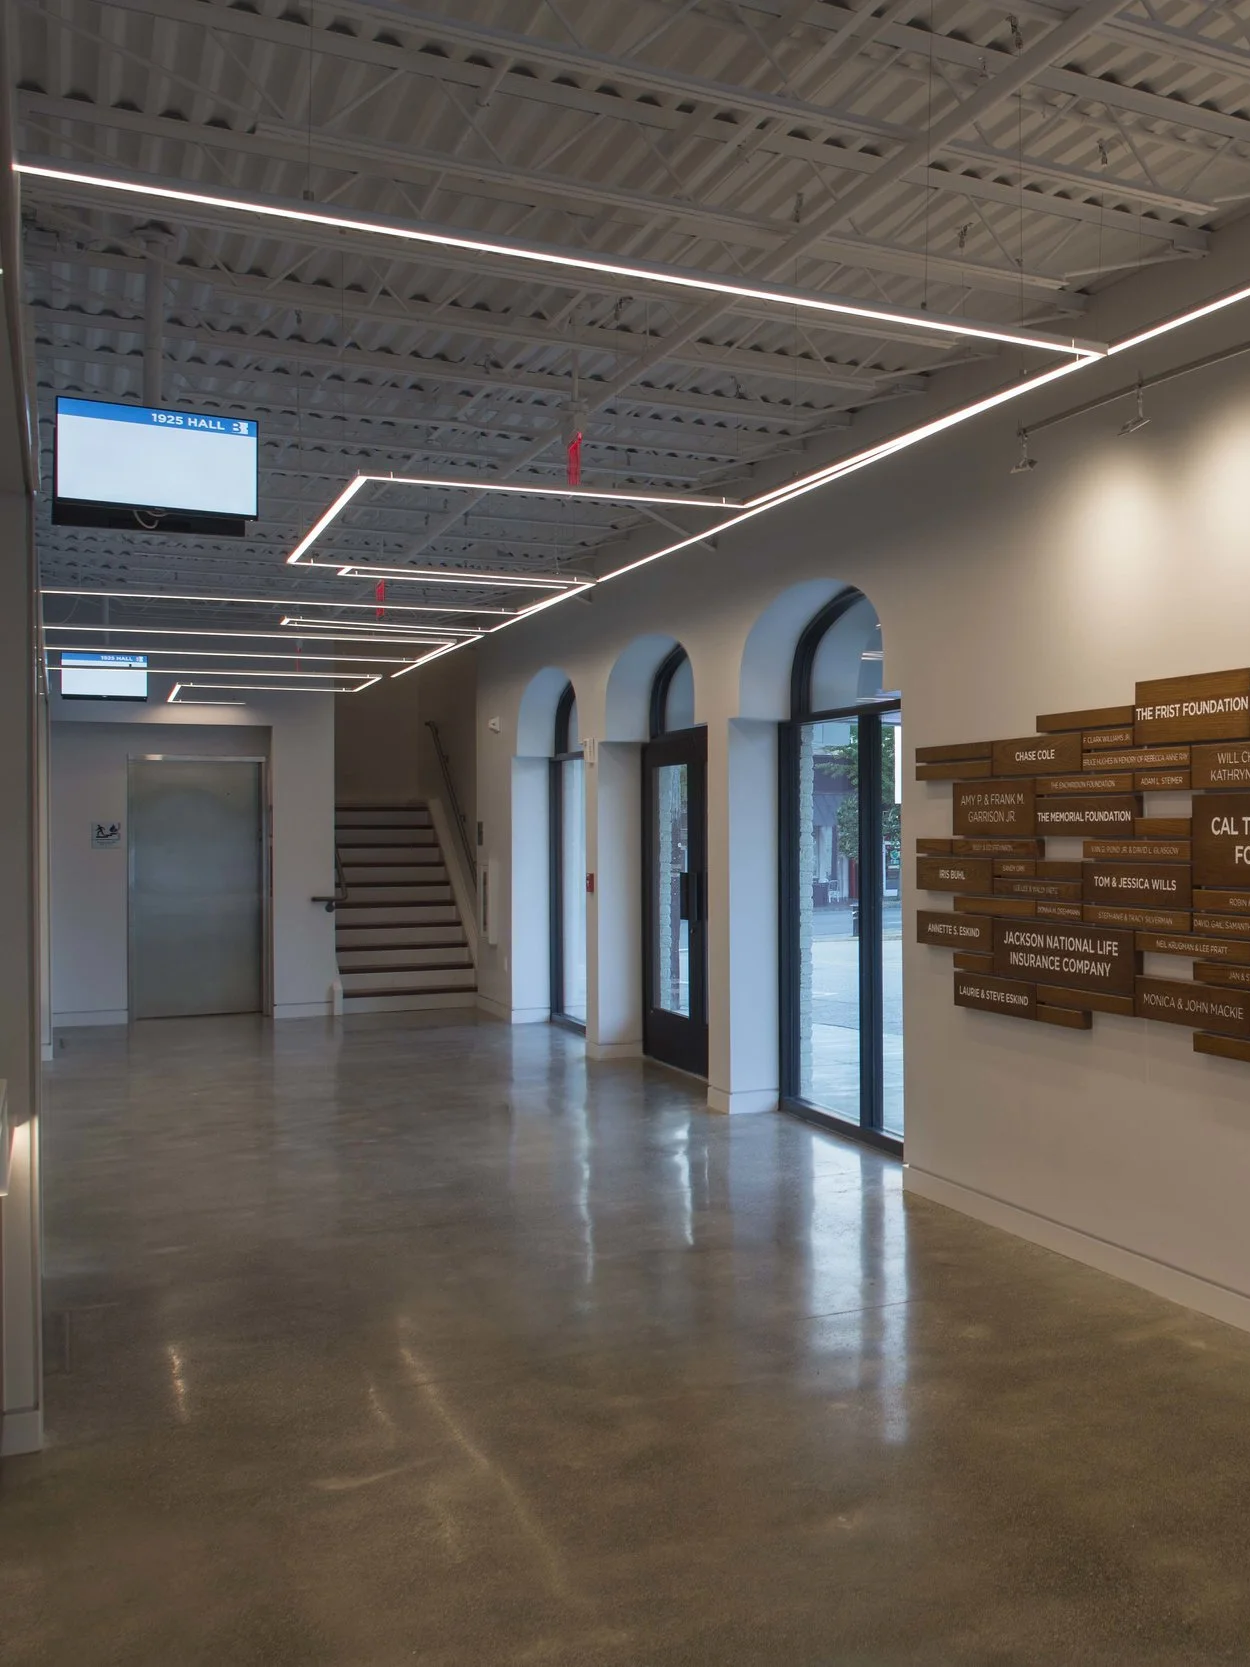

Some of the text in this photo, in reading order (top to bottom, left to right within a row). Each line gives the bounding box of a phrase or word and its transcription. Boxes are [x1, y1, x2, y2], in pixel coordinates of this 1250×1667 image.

[152, 414, 225, 430] 1925 HALL
[1136, 696, 1248, 721] THE FRIST FOUNDATION
[1015, 750, 1055, 761] CHASE COLE
[1218, 752, 1239, 764] WILL
[961, 795, 976, 806] AMY
[990, 794, 1016, 805] FRANK
[968, 811, 1005, 822] GARRISON
[1038, 811, 1131, 822] THE MEMORIAL FOUNDATION
[1212, 817, 1238, 836] CAL
[1094, 876, 1176, 891] TOM & JESSICA WILLS
[928, 924, 952, 935] ANNETTE
[960, 926, 980, 938] ESKIND
[1004, 931, 1118, 956] JACKSON NATIONAL LIFE
[1010, 952, 1111, 977] INSURANCE COMPANY
[960, 986, 980, 998] LAURIE
[986, 990, 1004, 1002] STEVE
[1006, 994, 1028, 1006] ESKIND
[1144, 993, 1244, 1020] MONICA & JOHN MACKIE
